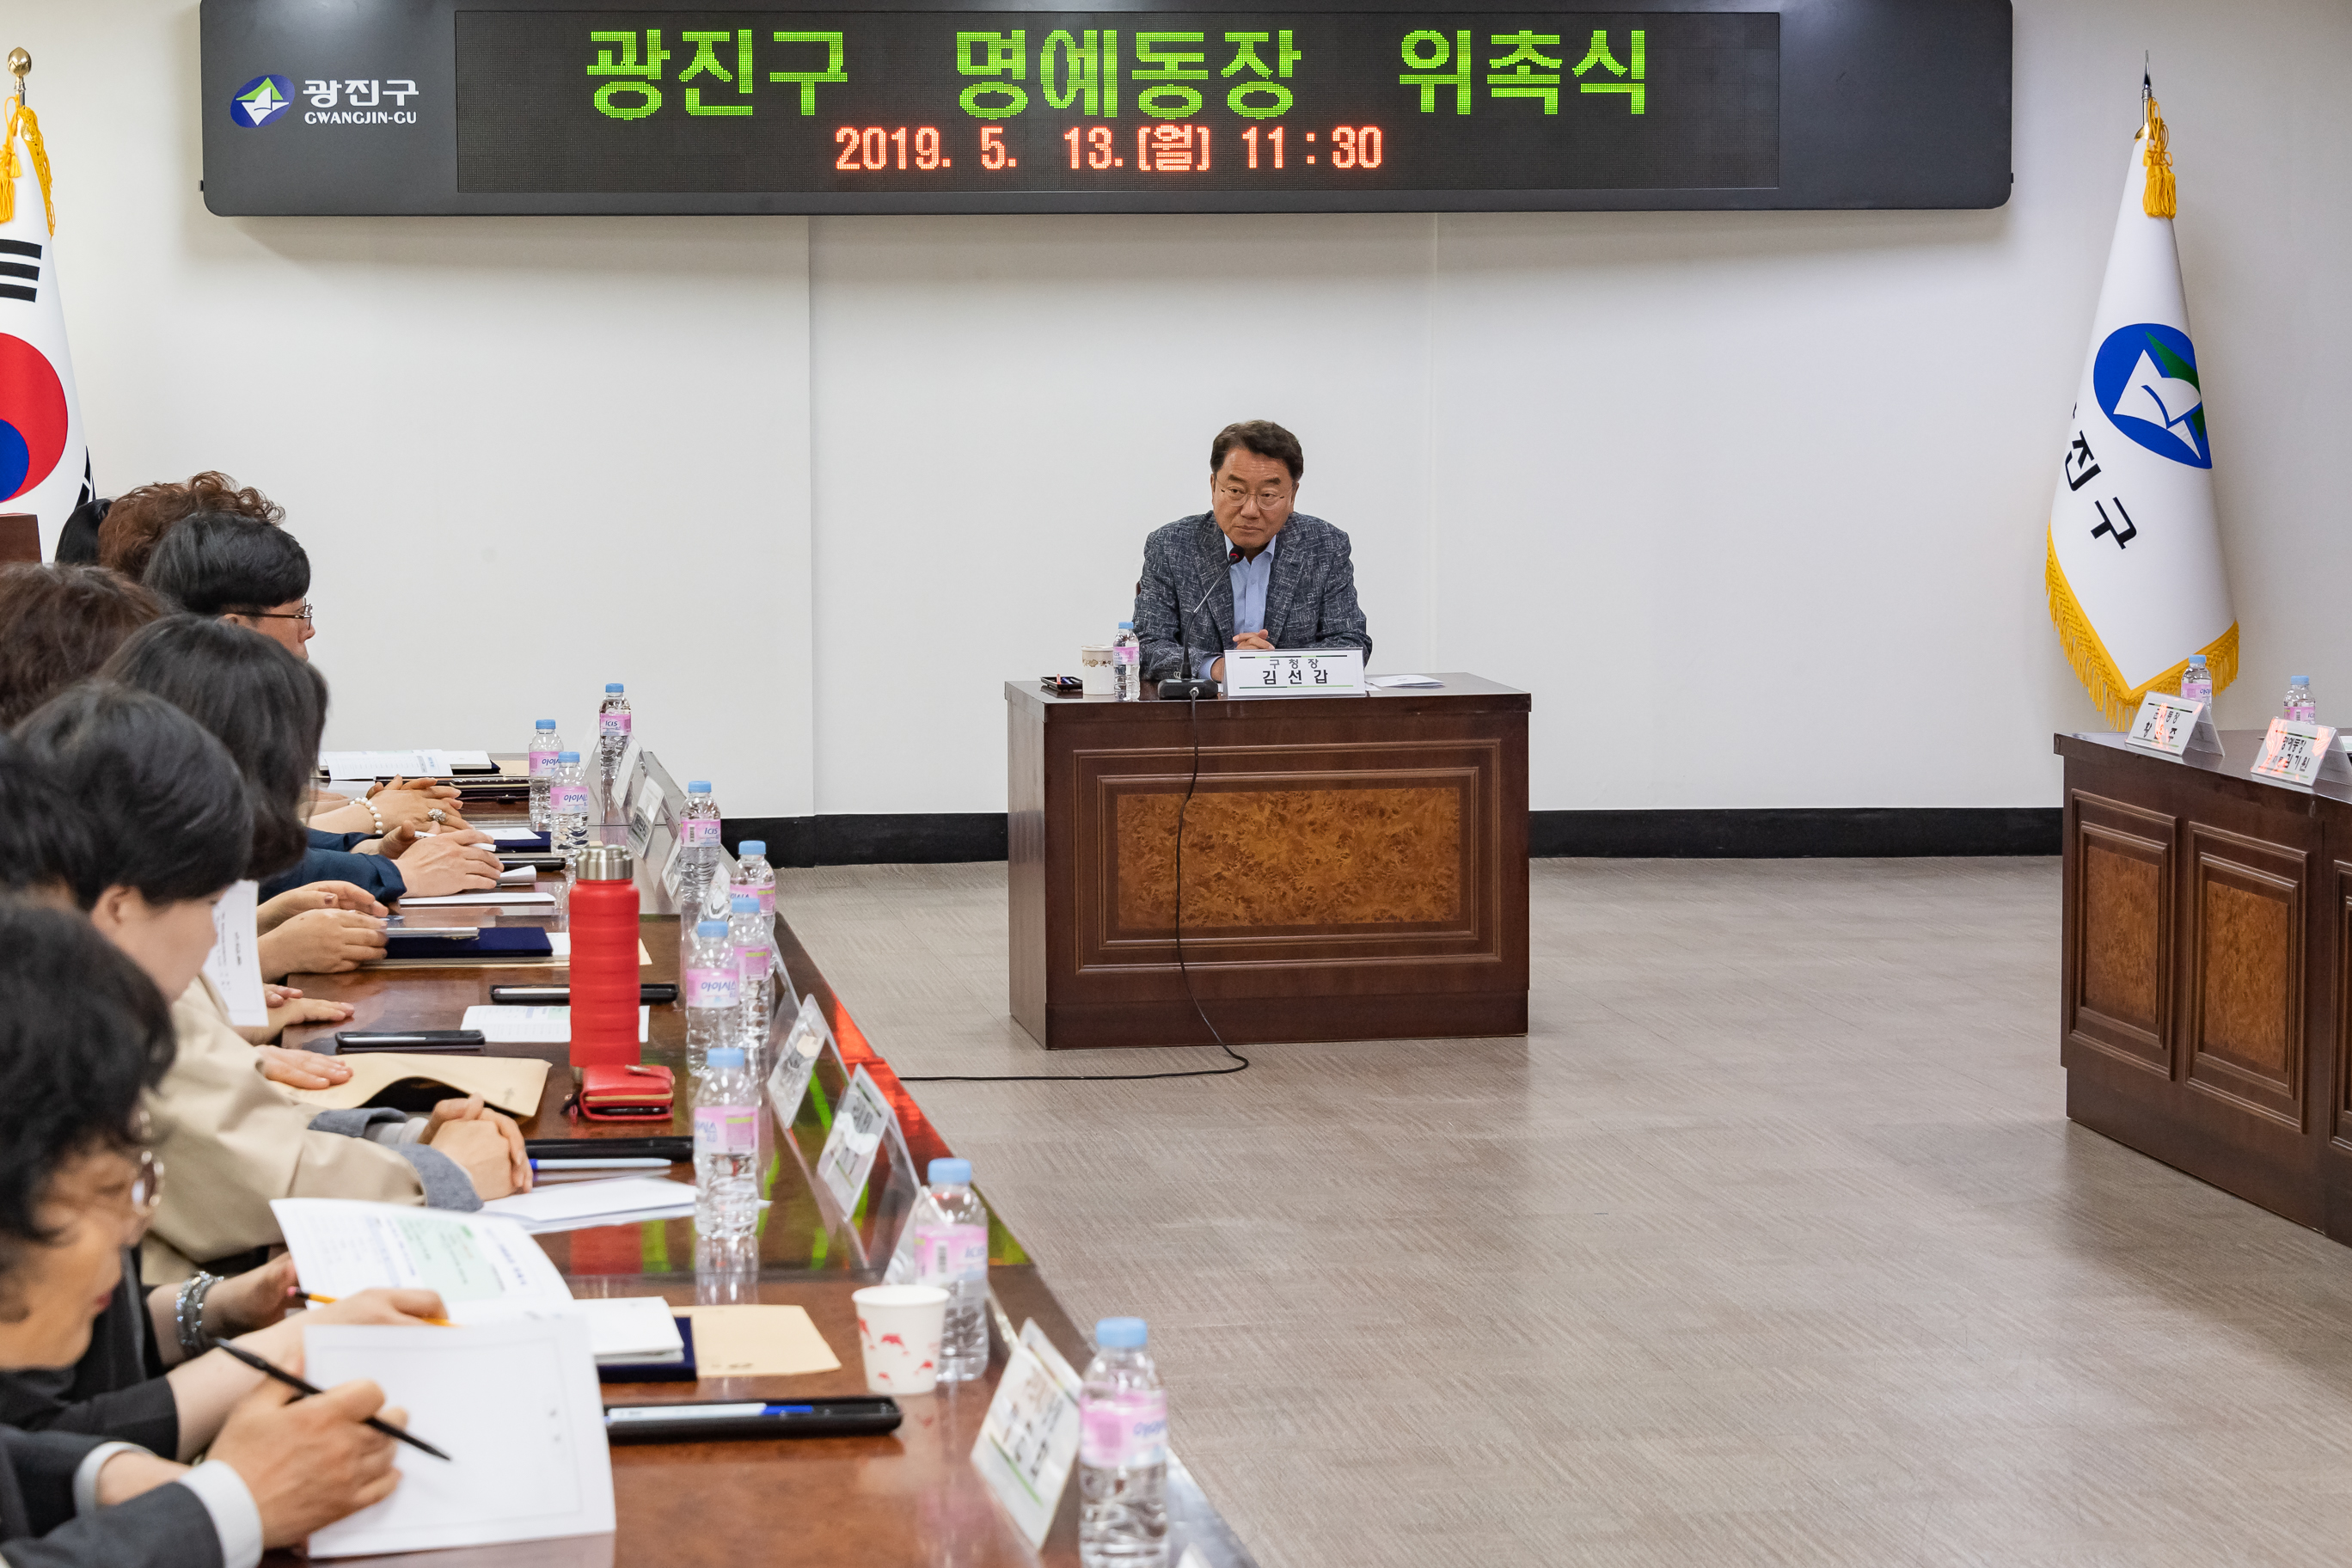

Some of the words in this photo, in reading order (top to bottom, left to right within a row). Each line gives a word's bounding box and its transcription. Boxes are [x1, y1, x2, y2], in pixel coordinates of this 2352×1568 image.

[303, 79, 420, 108] 광진구
[586, 28, 848, 121] 광진구
[956, 28, 1302, 121] 명예동장
[1399, 28, 1645, 116] 위촉식
[304, 111, 417, 125] GWANGJIN-GU
[835, 126, 952, 170] 2019.
[979, 126, 1018, 170] 5.
[2065, 401, 2137, 550] 진구
